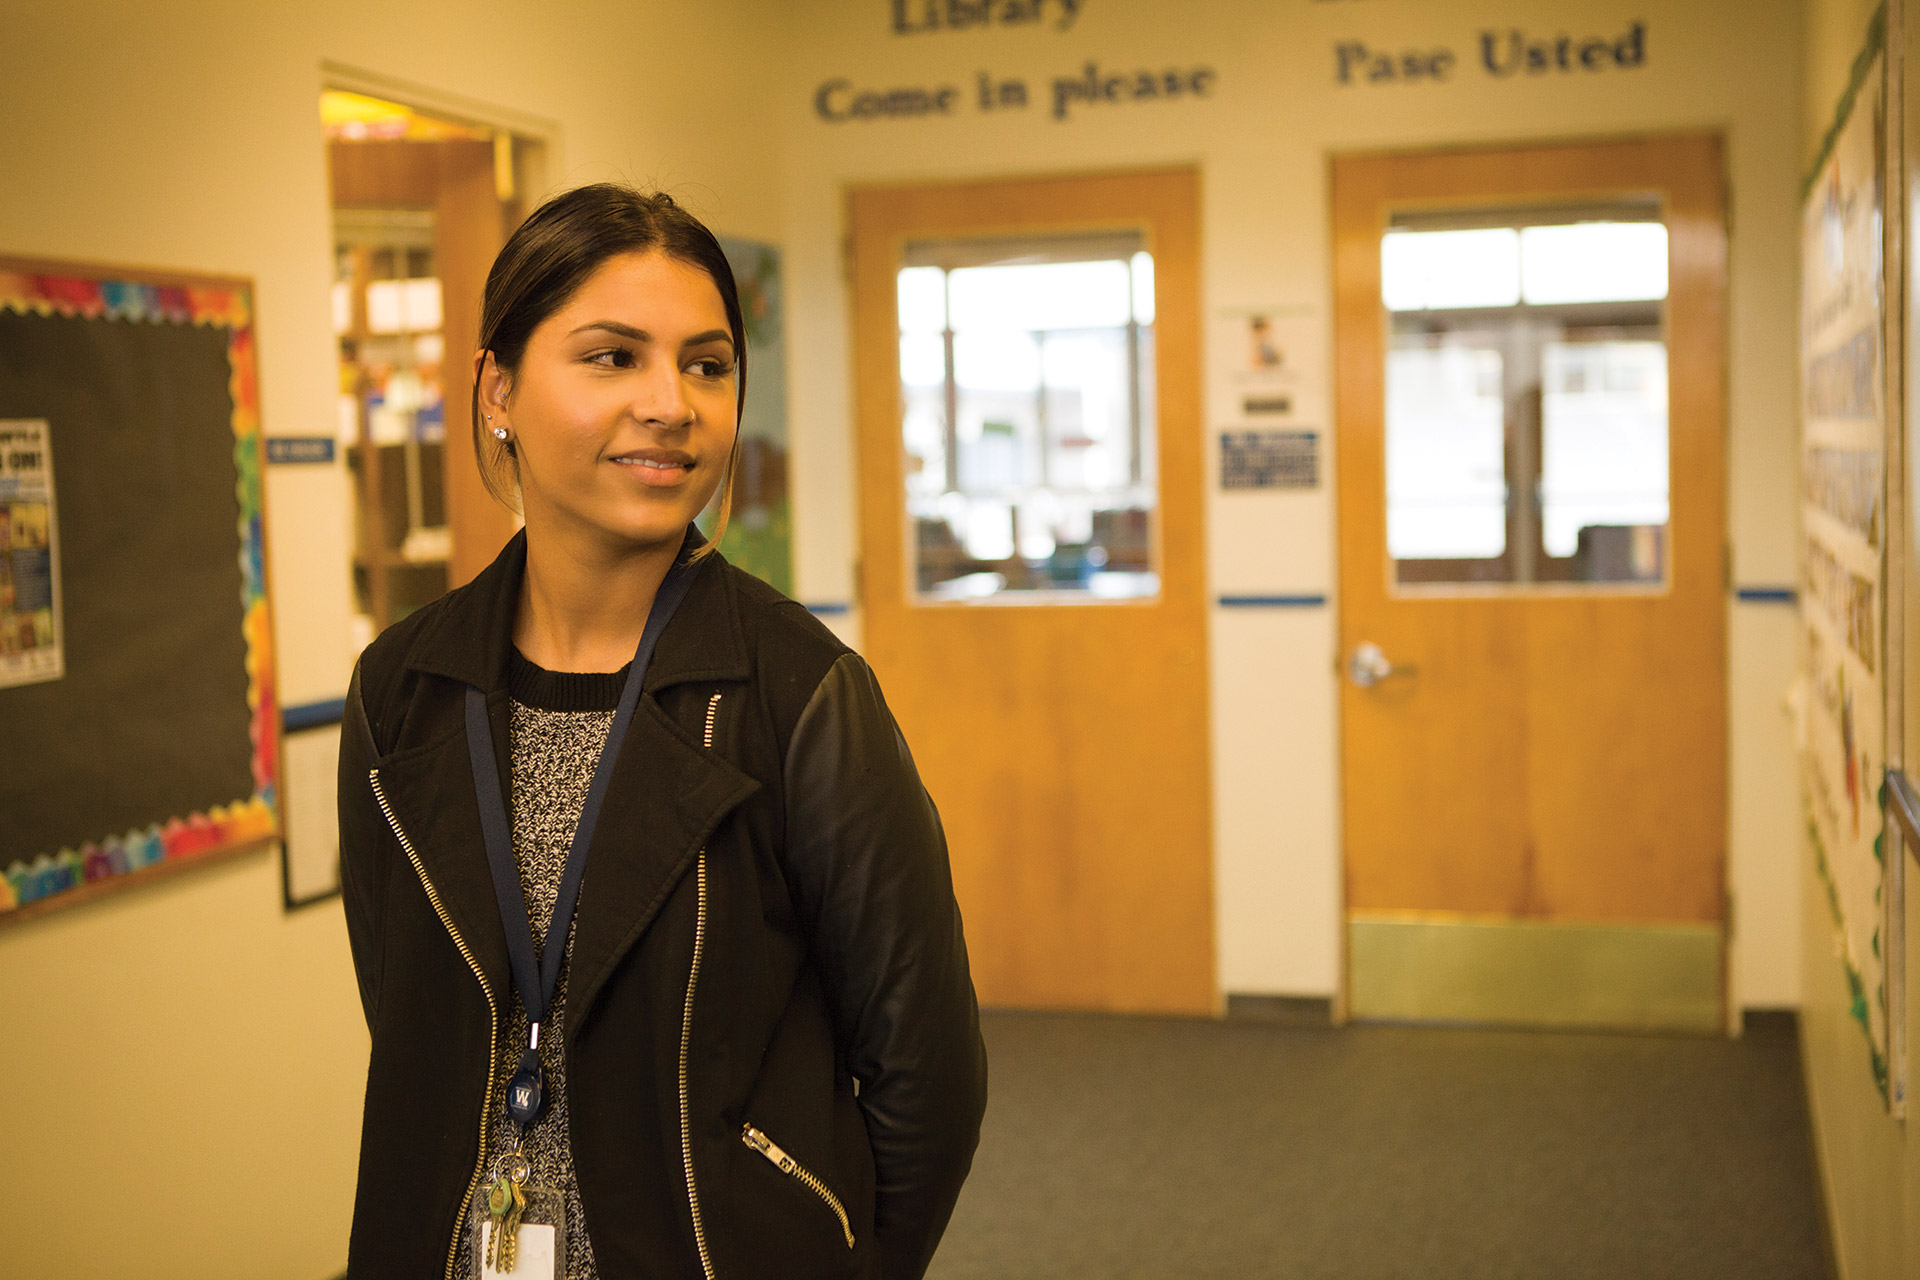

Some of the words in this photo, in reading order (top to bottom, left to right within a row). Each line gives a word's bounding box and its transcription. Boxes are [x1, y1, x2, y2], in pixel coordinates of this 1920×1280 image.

[892, 0, 1085, 36] Library
[1335, 40, 1454, 85] Pase
[1480, 20, 1647, 77] Usted
[814, 78, 958, 123] Come
[977, 70, 1027, 112] in
[1053, 60, 1215, 121] please
